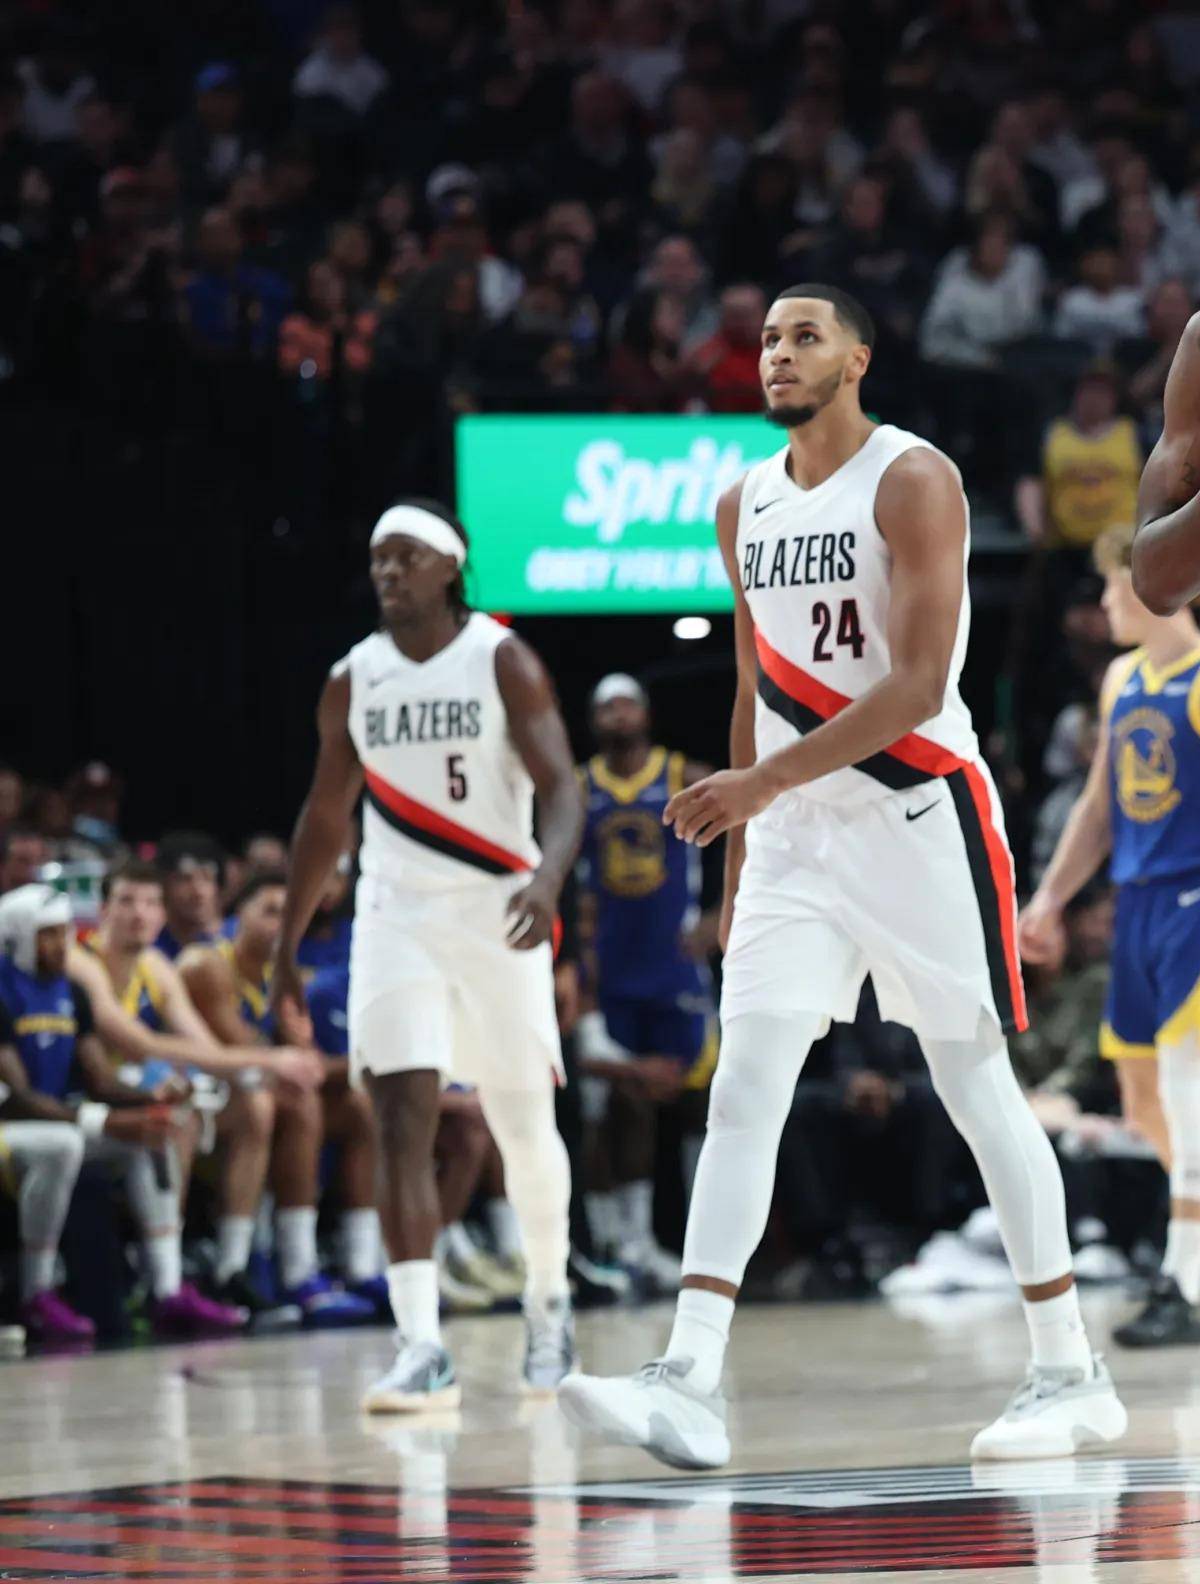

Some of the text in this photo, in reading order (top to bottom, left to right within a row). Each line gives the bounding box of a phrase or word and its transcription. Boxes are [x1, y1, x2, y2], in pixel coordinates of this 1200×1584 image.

[562, 438, 766, 543] Sprit
[743, 531, 856, 591] BLAZERS
[812, 598, 865, 661] 24
[365, 700, 480, 749] BLAZERS
[447, 754, 467, 802] 5
